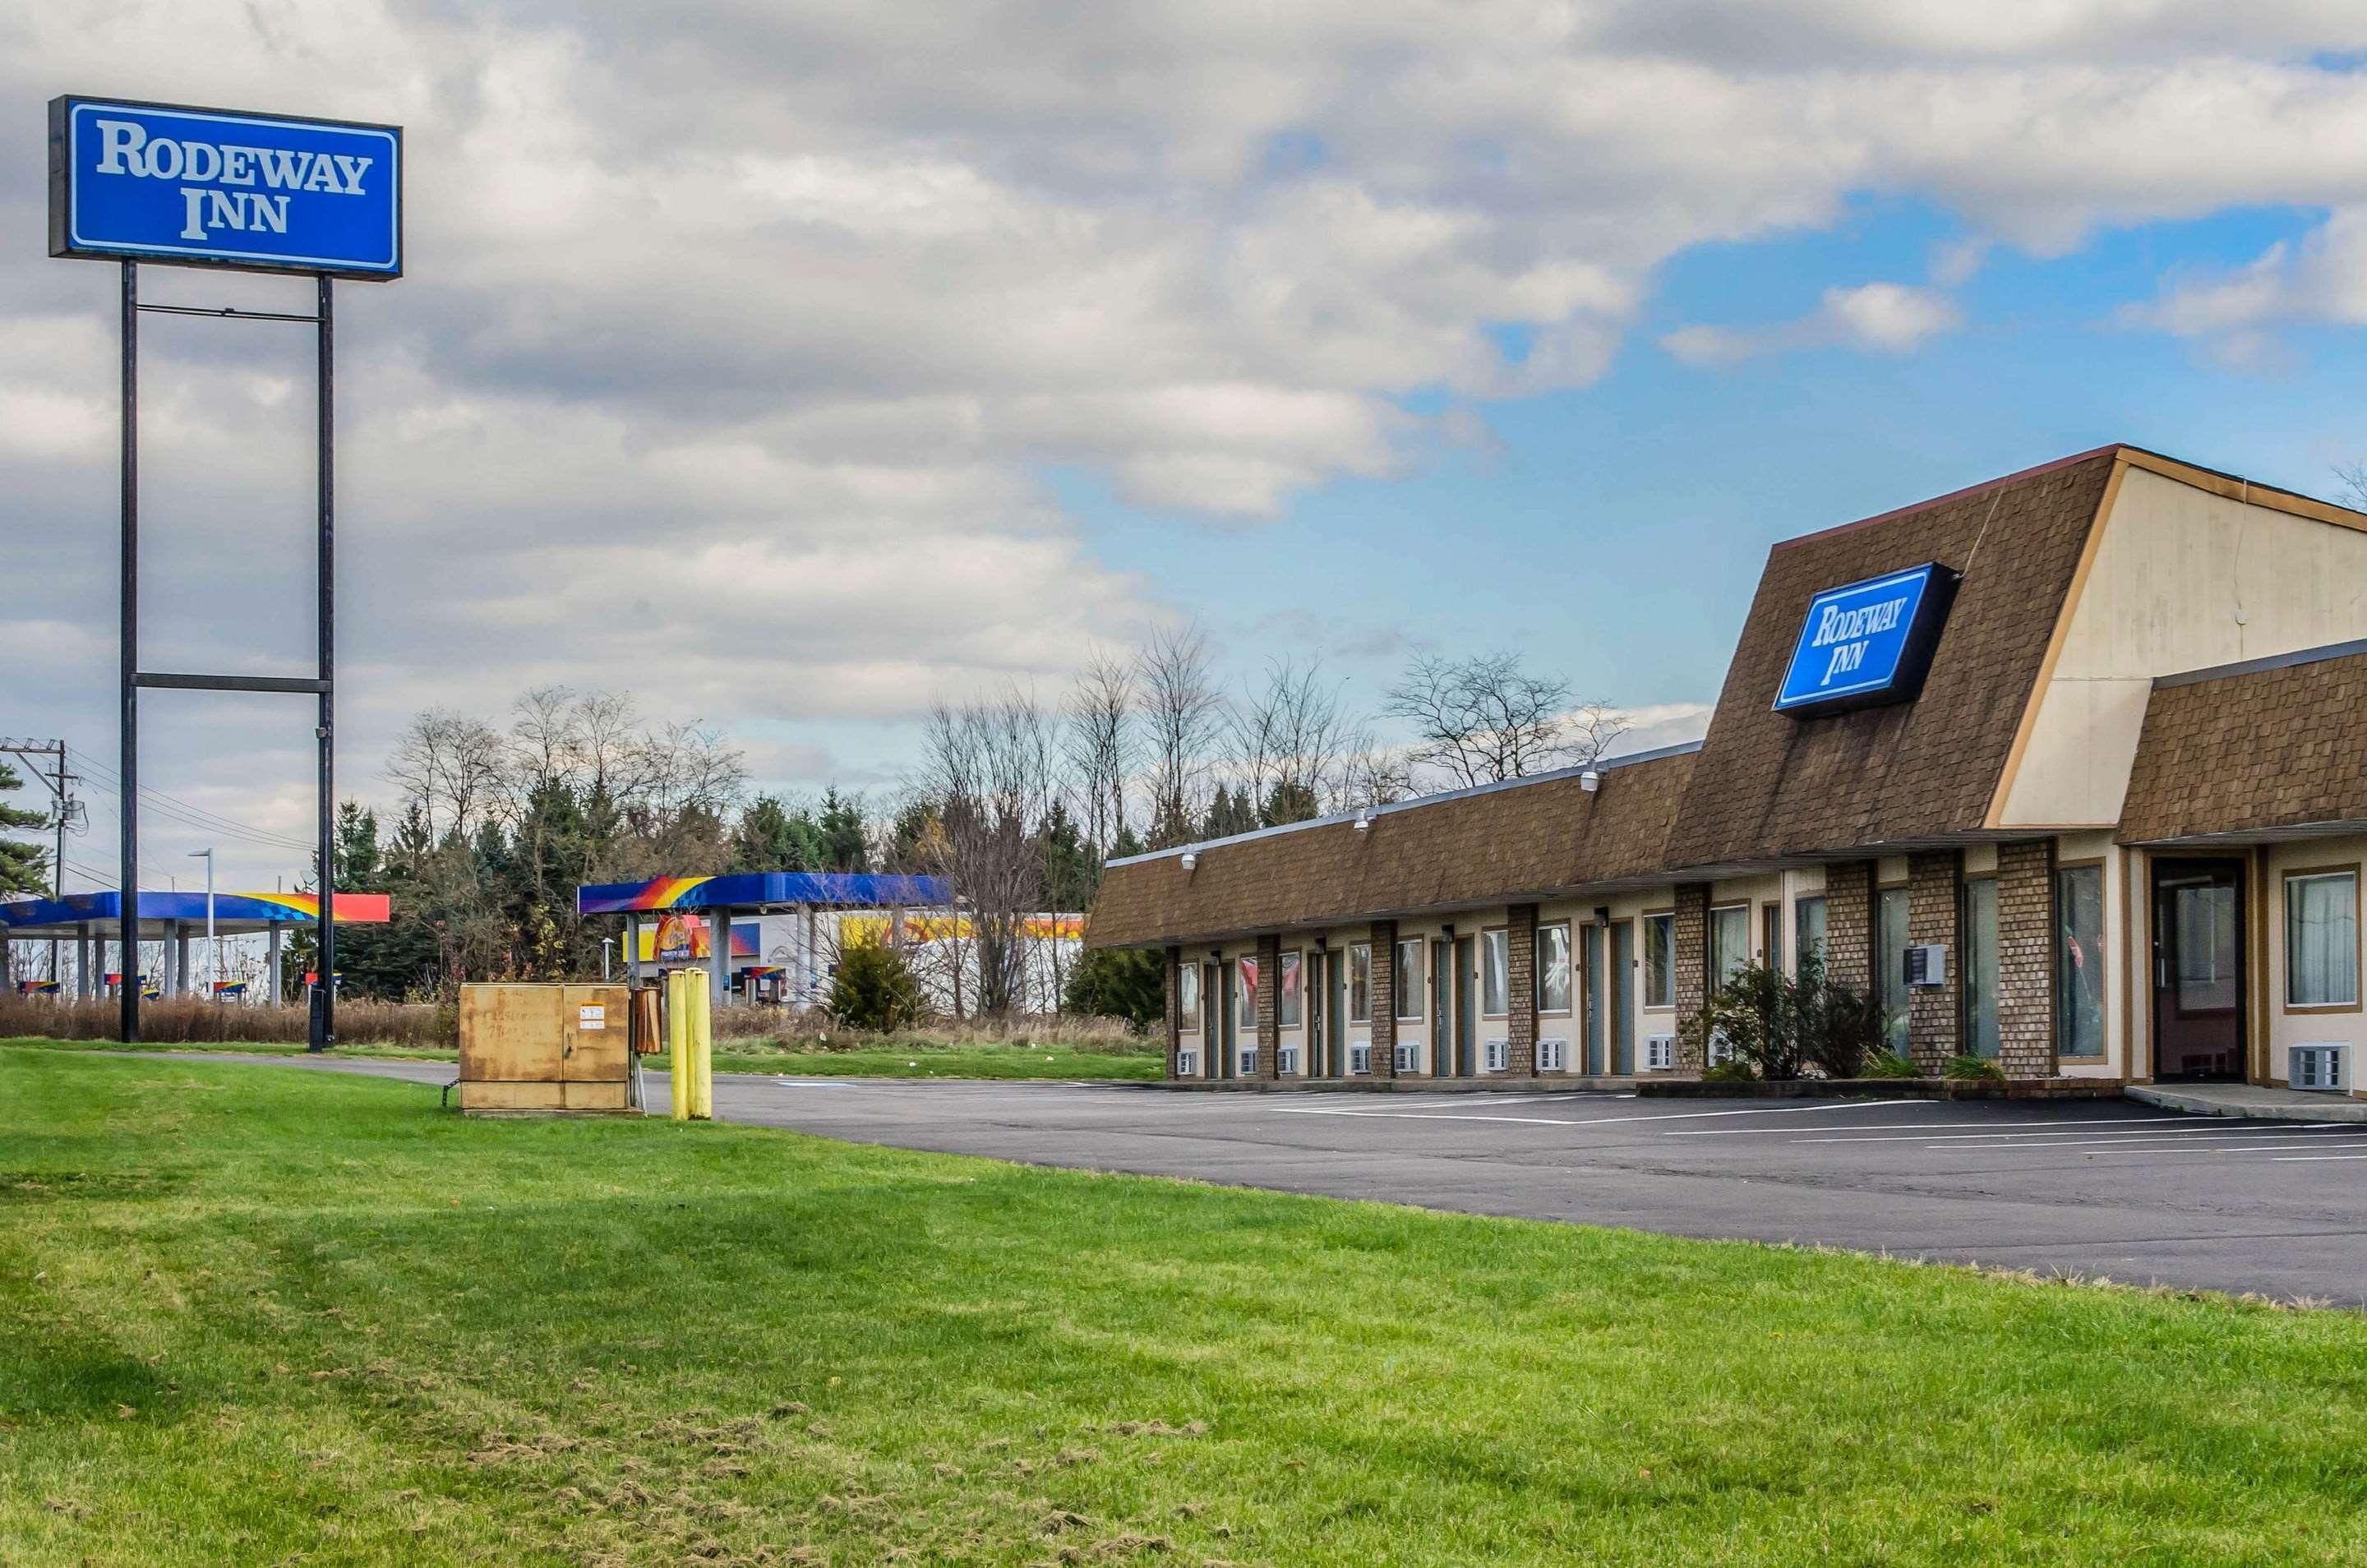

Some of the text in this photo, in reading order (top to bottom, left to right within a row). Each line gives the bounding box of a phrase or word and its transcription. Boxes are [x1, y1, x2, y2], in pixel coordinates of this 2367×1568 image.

[96, 119, 373, 195] RODEWAY
[180, 187, 290, 241] INN
[1811, 597, 1907, 647] RODEWAY
[1820, 640, 1869, 686] INN
